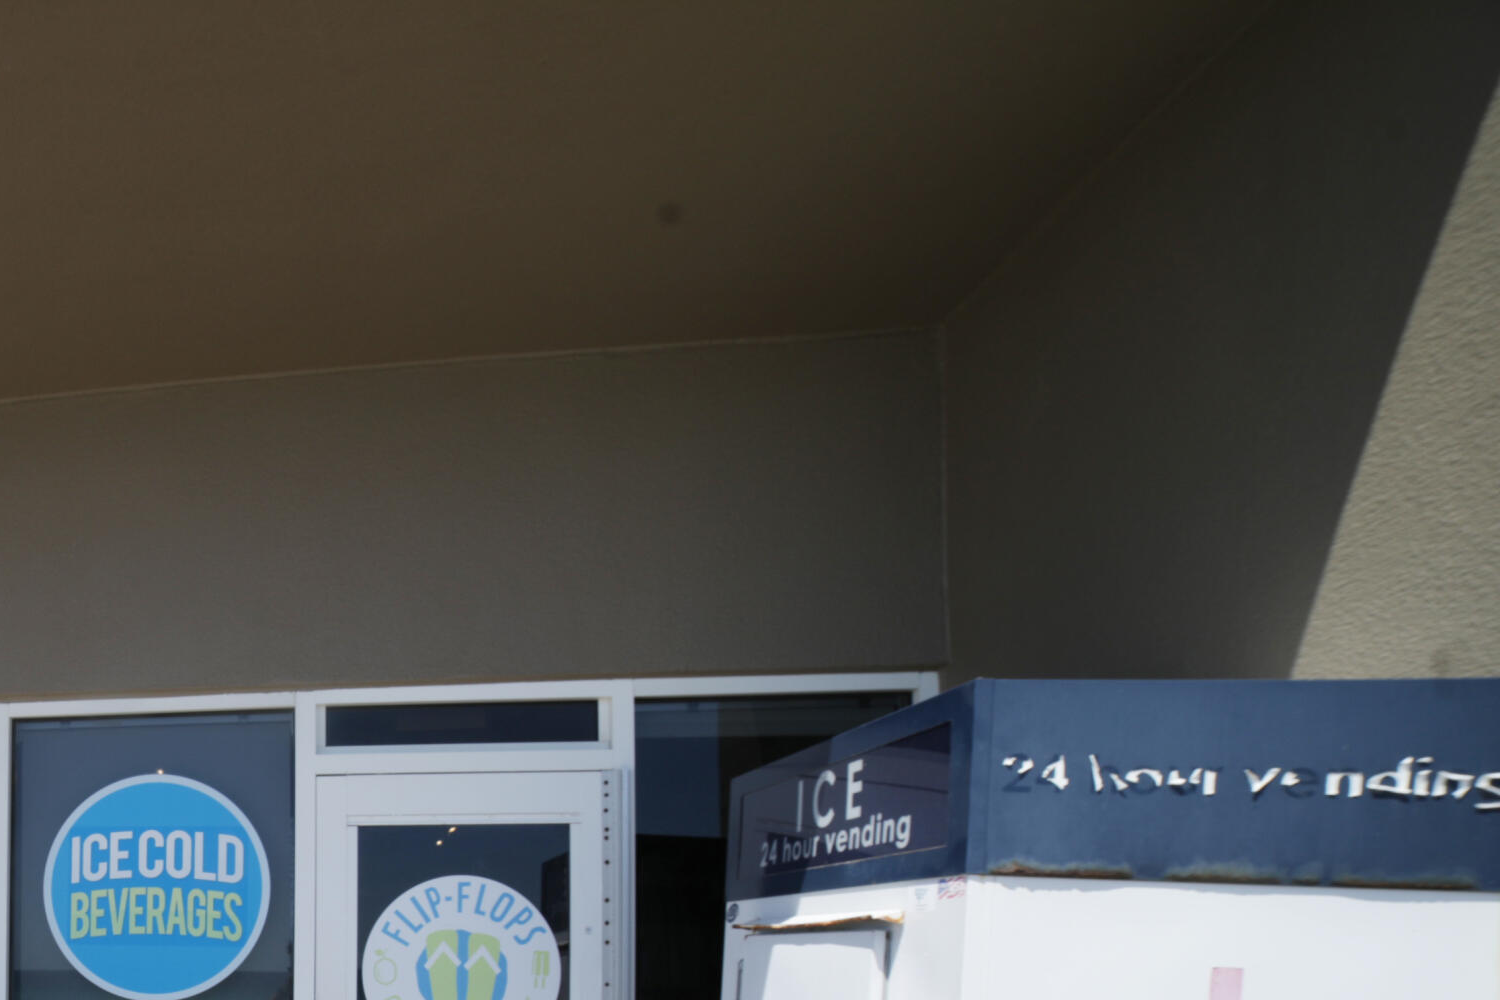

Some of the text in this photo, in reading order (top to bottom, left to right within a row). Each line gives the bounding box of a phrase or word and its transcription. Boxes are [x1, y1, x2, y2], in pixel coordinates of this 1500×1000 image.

[796, 759, 864, 833] ICE
[70, 829, 244, 884] ICE COLD
[759, 812, 912, 867] 24 hour vending
[70, 886, 243, 942] BEVERAGES
[381, 881, 547, 946] FLIP-FLOPS
